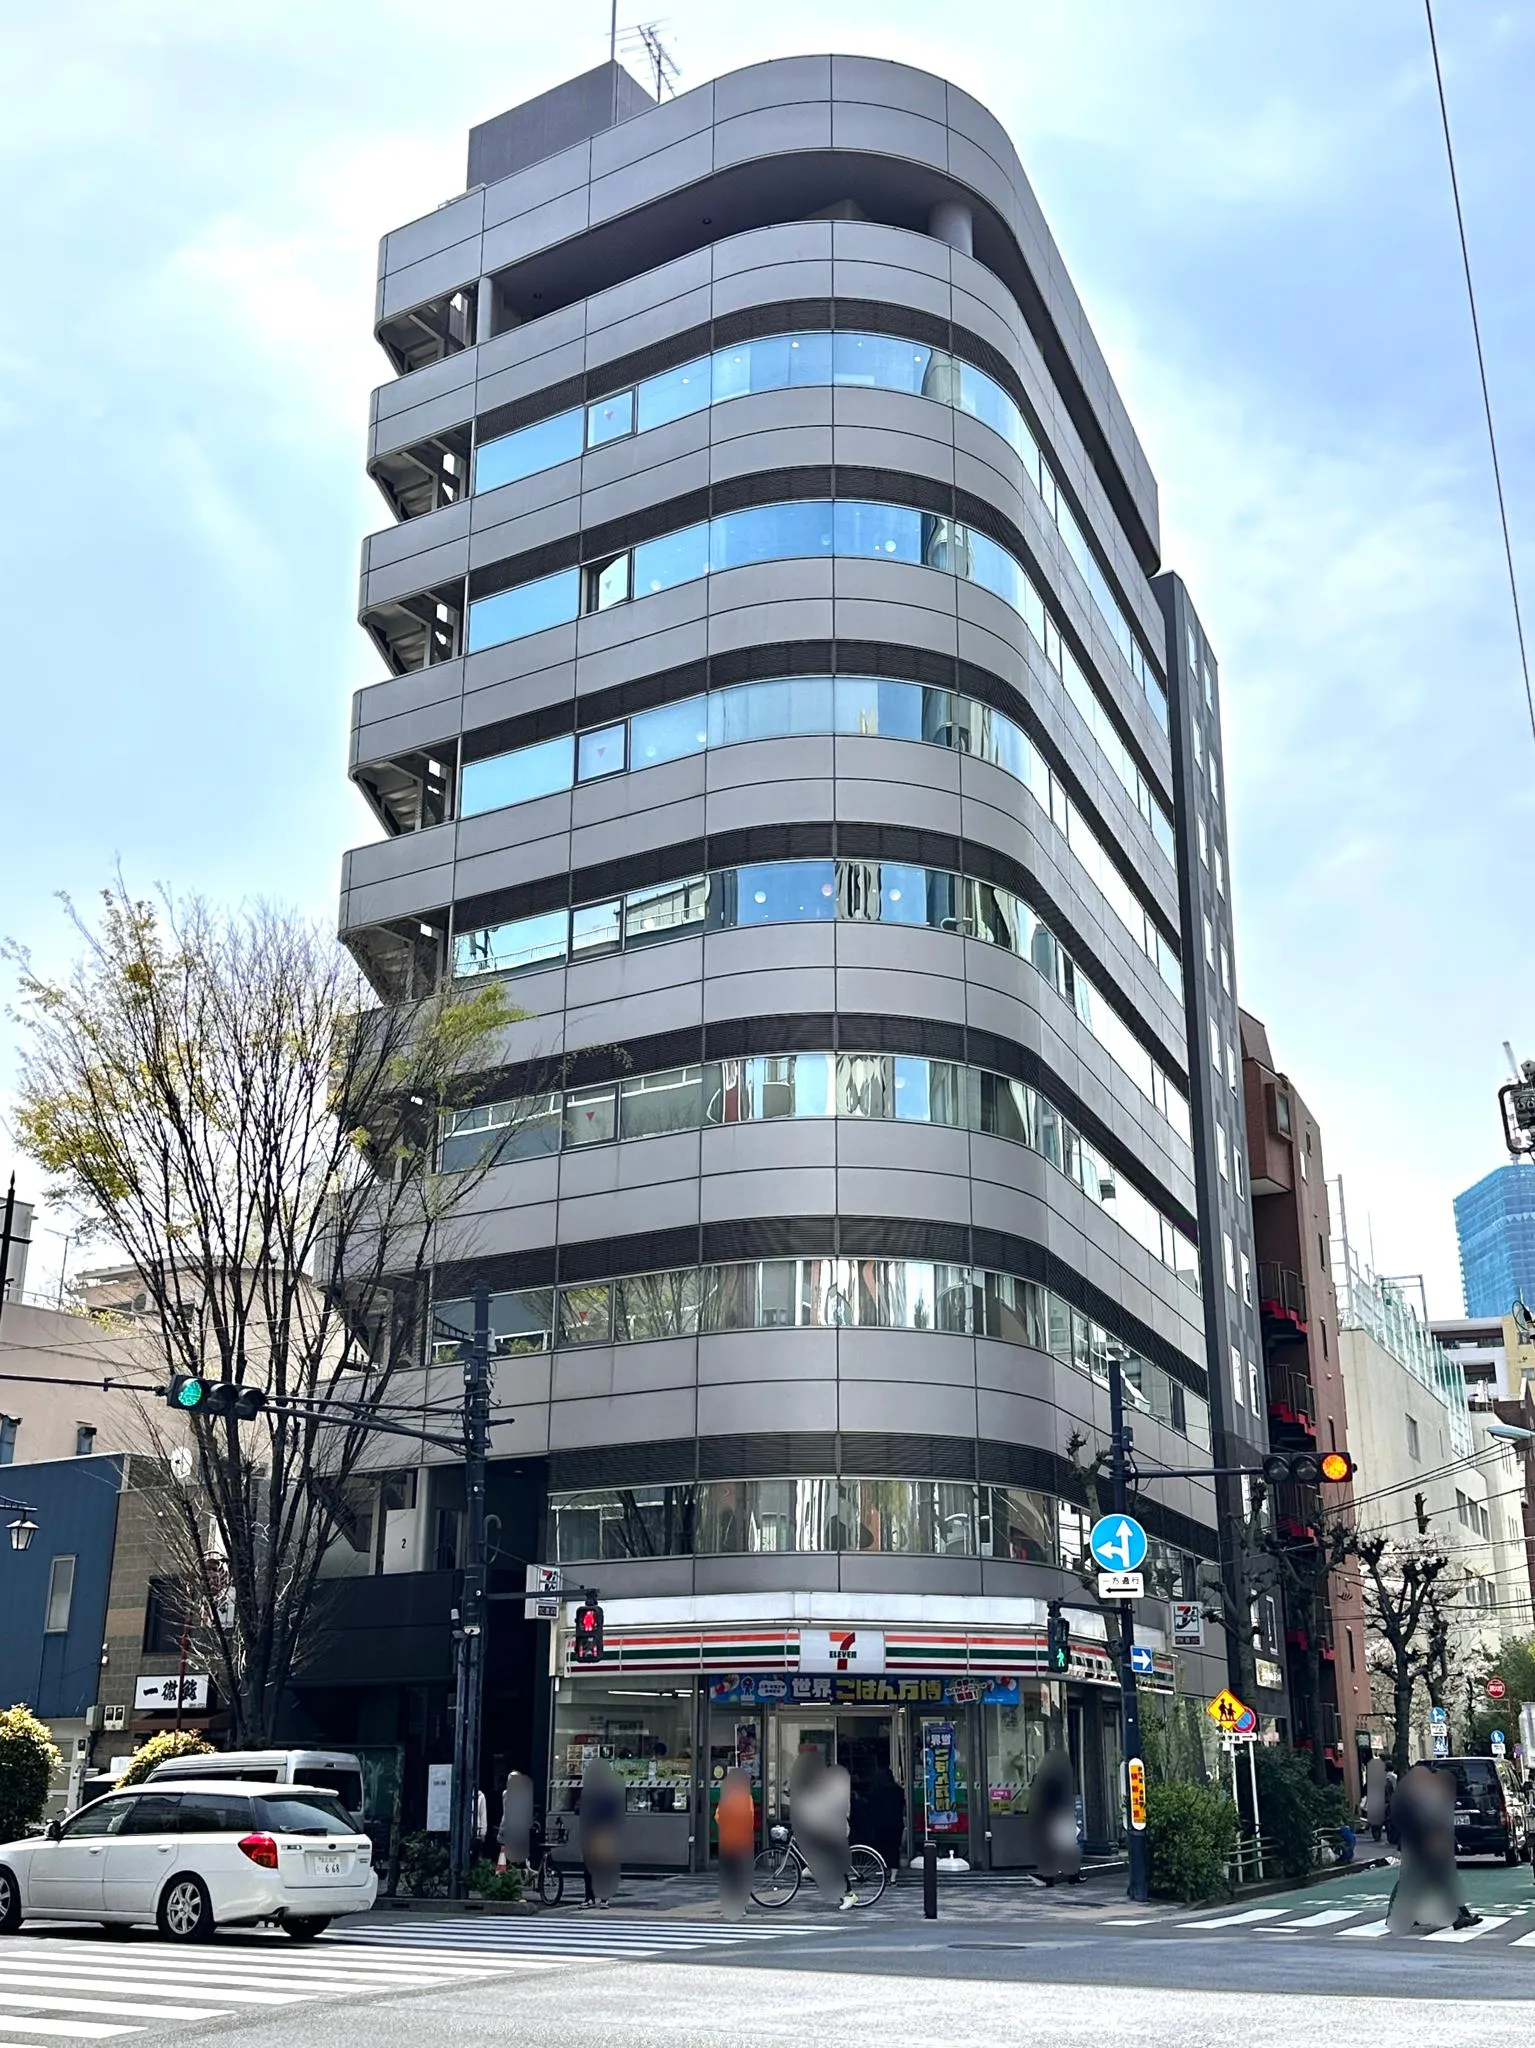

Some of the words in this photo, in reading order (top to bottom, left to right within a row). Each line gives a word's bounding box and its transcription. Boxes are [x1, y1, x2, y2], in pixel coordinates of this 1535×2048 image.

[401, 1538, 407, 1549] 2
[1102, 1576, 1140, 1585] 一方通行
